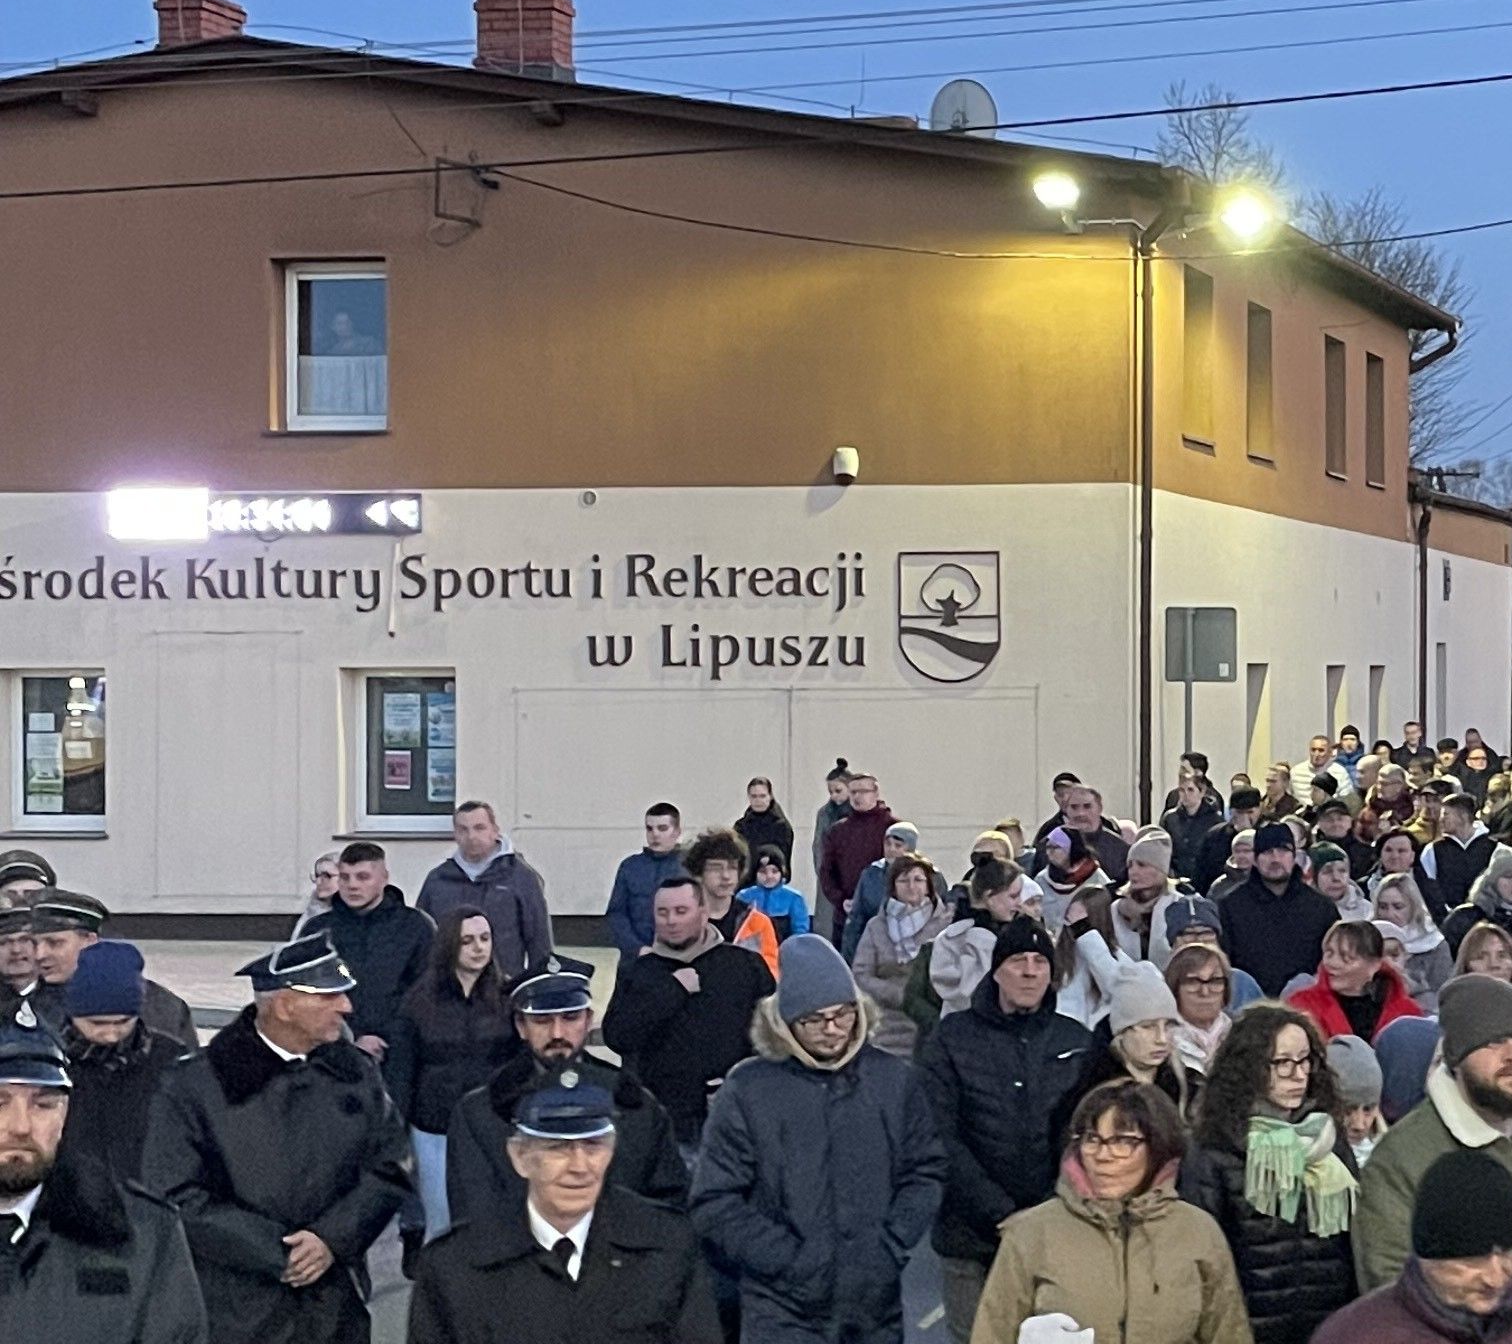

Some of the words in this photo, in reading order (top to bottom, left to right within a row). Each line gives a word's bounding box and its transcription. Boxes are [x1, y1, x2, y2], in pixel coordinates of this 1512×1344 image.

[0, 555, 169, 601] środek
[186, 557, 382, 613] Kultury
[399, 554, 573, 613] Sportu
[591, 554, 603, 600] i
[625, 552, 866, 613] Rekreacji
[586, 635, 634, 667] w
[660, 623, 866, 681] Lipuszu
